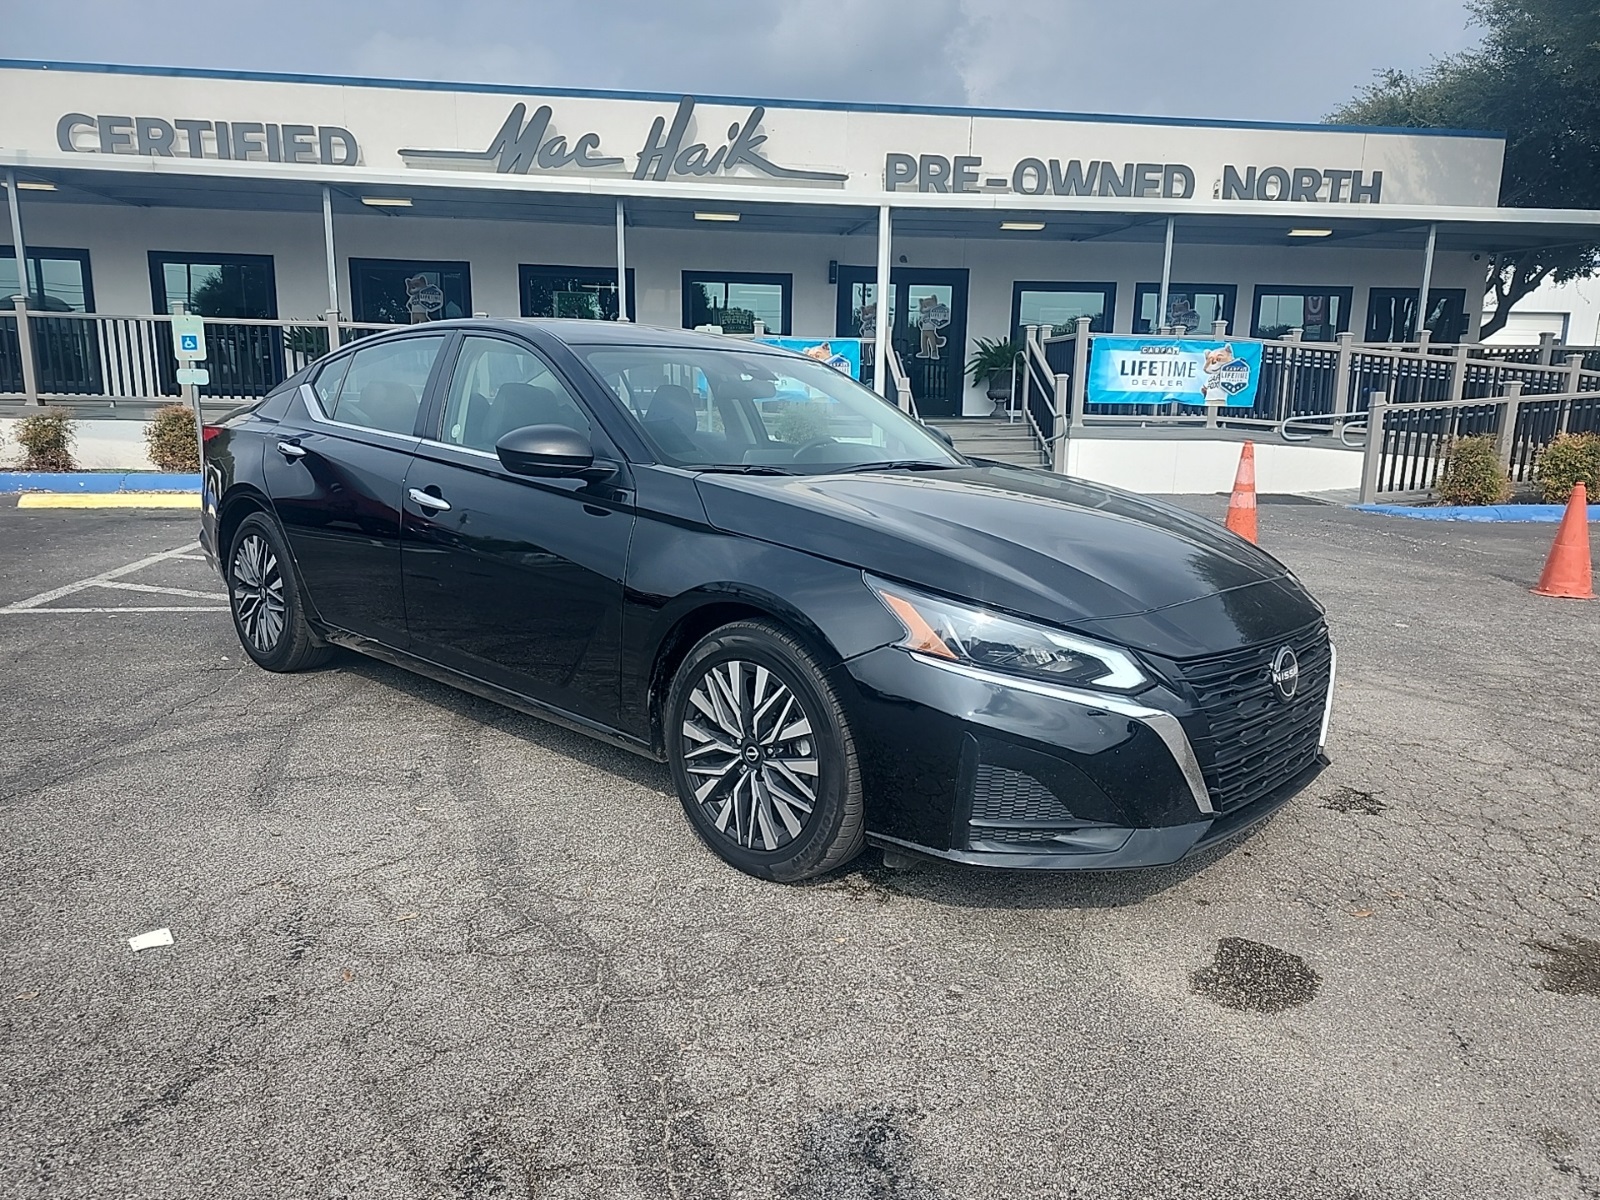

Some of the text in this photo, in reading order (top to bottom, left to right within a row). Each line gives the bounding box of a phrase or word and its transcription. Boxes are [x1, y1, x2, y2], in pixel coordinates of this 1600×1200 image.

[57, 112, 360, 167] CERTIFIED
[397, 95, 849, 181] Mac Haik
[885, 152, 1383, 204] PRE-OWNED NORTH
[1120, 359, 1198, 378] LIFETIME
[1141, 346, 1180, 356] CARFAX
[1131, 379, 1184, 387] DEALER
